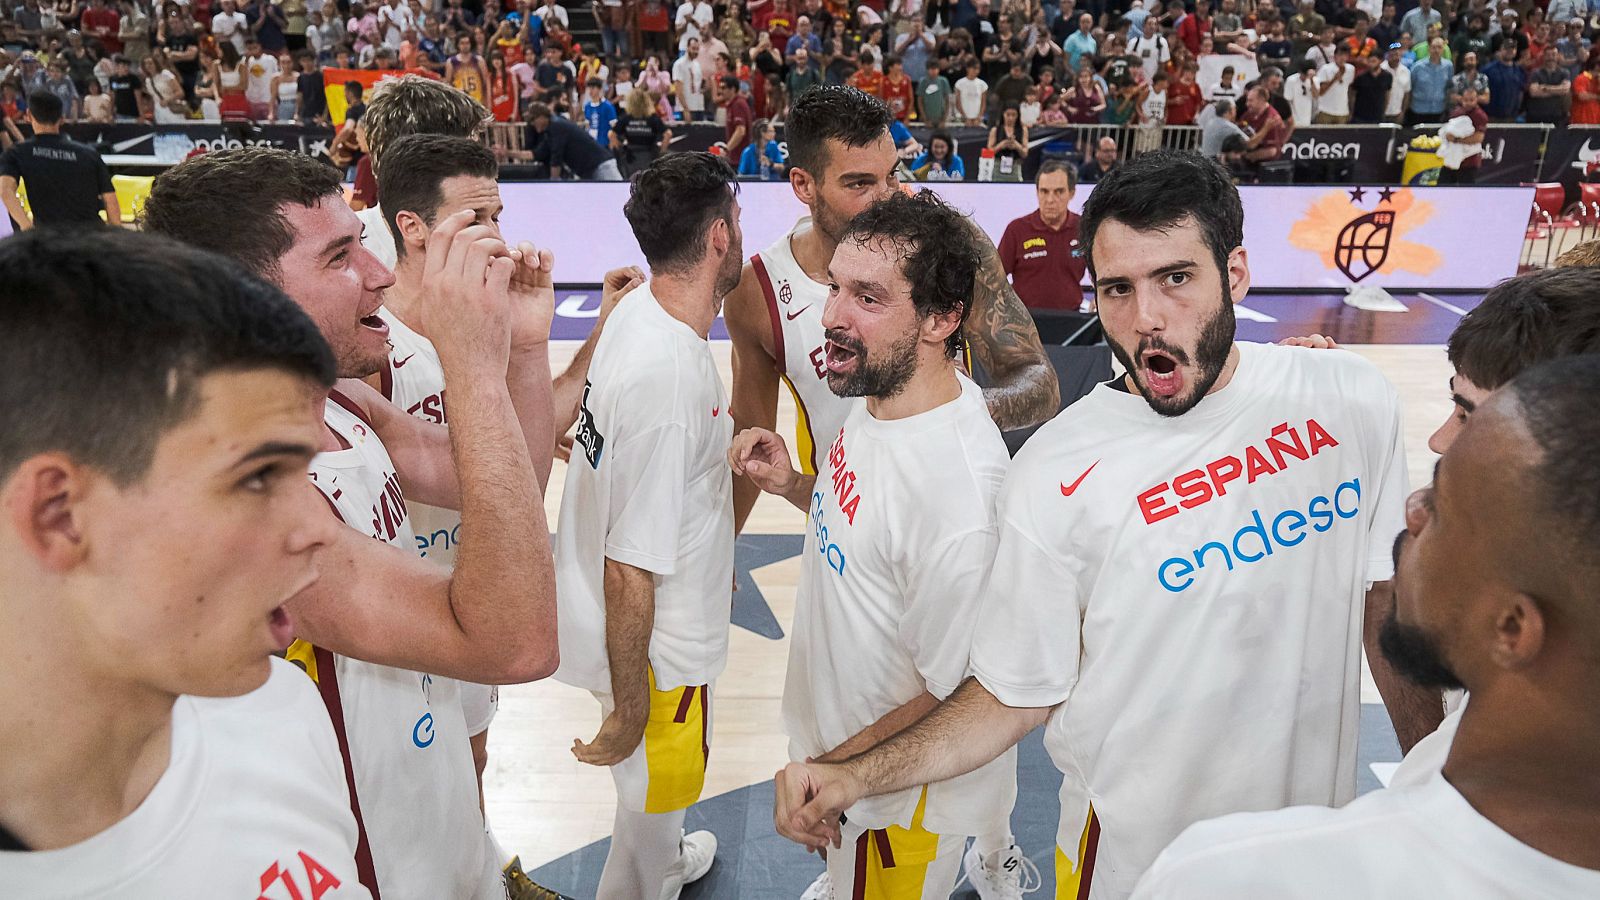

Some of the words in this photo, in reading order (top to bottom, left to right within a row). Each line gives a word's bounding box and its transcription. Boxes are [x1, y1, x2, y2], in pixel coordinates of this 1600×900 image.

[32, 146, 78, 162] ARGENTINA
[1281, 137, 1361, 161] ndesa
[1136, 418, 1340, 526] ESPAÑA
[811, 491, 846, 577] desa
[1158, 477, 1362, 593] endesa
